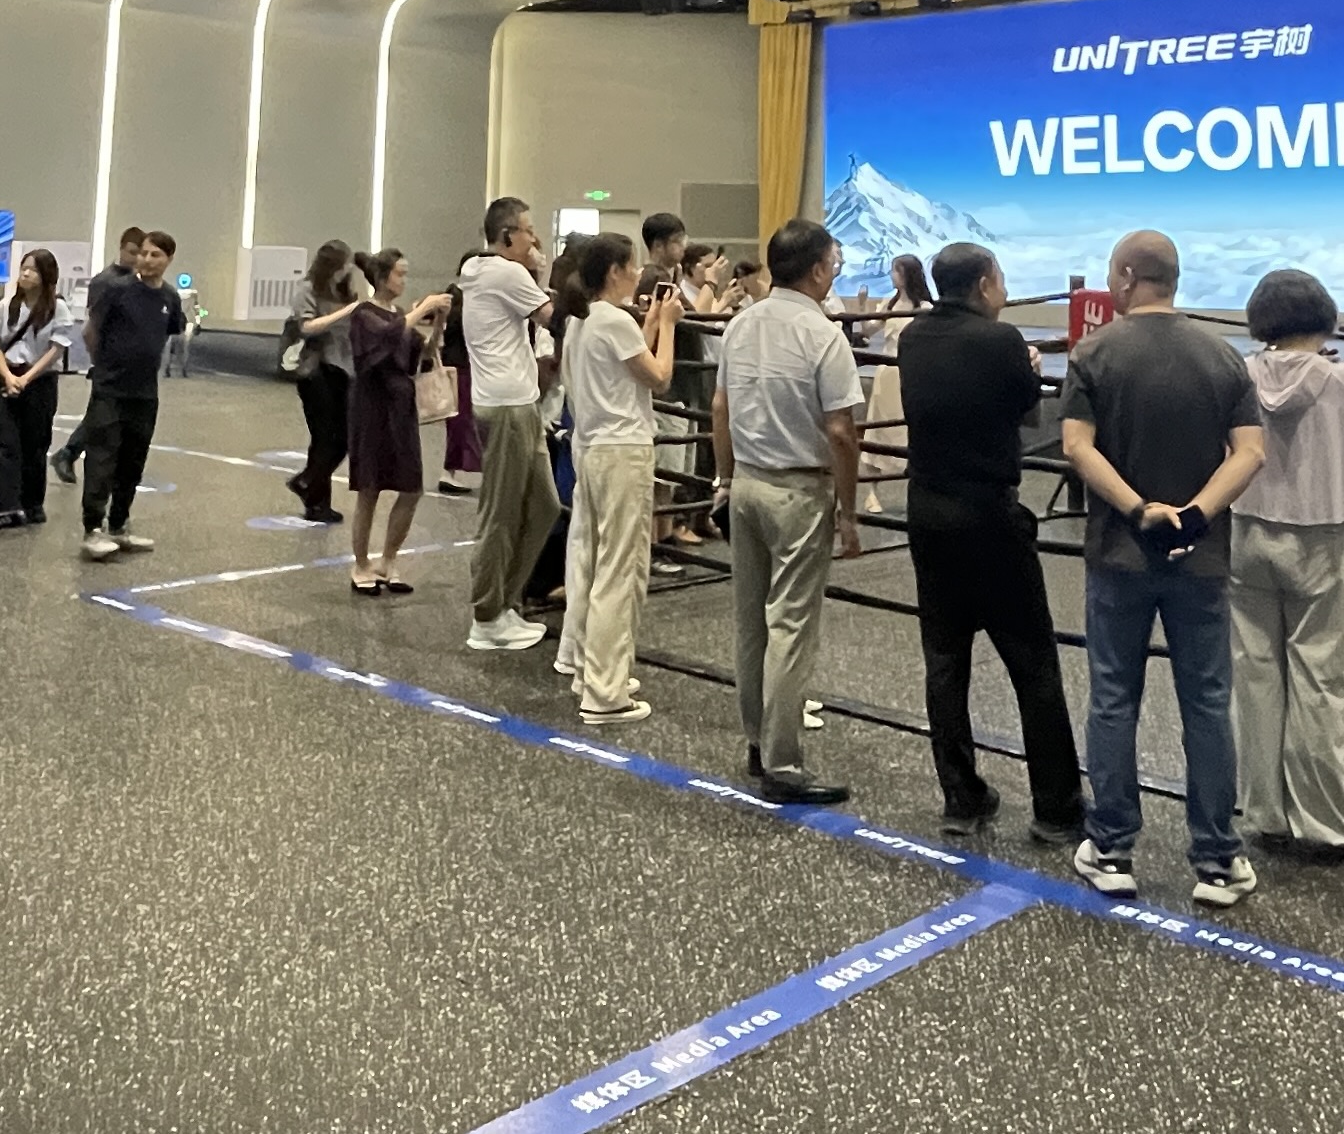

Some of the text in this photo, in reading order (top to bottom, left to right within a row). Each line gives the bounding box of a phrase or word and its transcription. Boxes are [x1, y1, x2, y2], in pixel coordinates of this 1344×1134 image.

[1052, 23, 1313, 75] UNITREE 宇树
[875, 931, 938, 961] Media
[1195, 929, 1276, 960] Media
[650, 1033, 731, 1075] Media
[725, 1008, 783, 1040] Area
